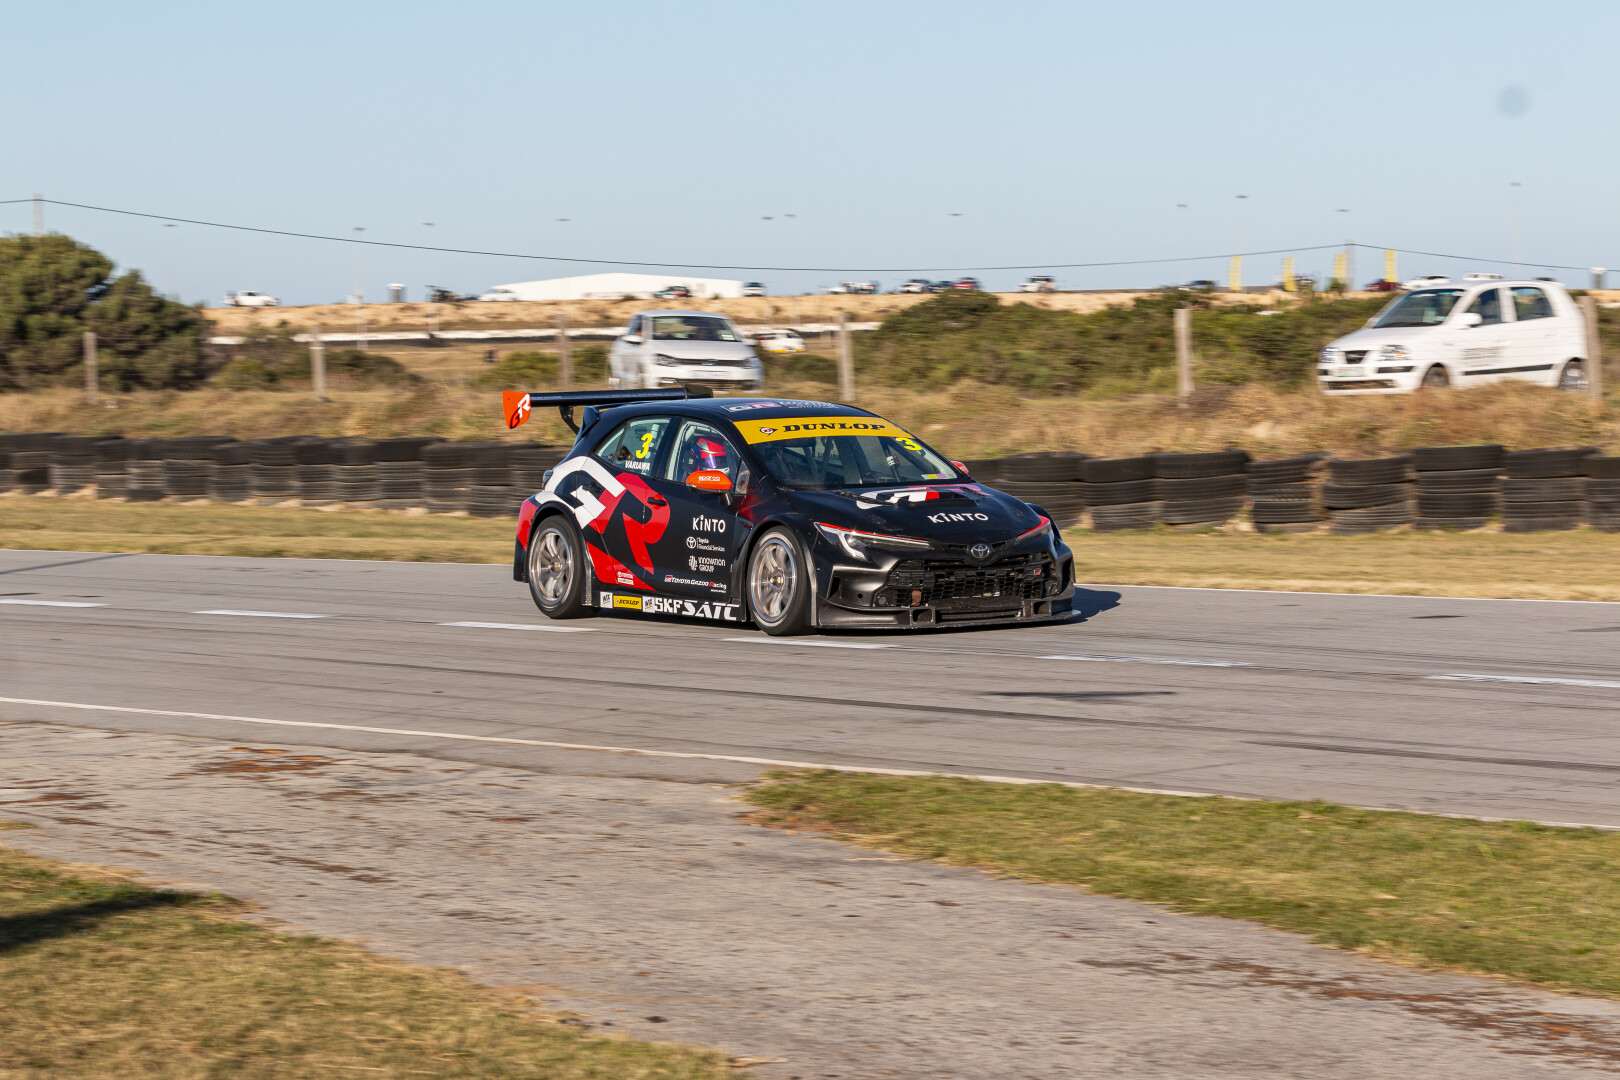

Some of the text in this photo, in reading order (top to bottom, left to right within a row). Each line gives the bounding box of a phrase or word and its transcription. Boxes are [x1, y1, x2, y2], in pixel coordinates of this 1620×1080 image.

[782, 422, 886, 433] DUNLOP
[635, 432, 653, 459] 3
[895, 436, 922, 451] 3
[699, 564, 715, 573] GROUP
[709, 581, 727, 590] Racing
[655, 597, 683, 614] SKF
[681, 599, 740, 621] SATC
